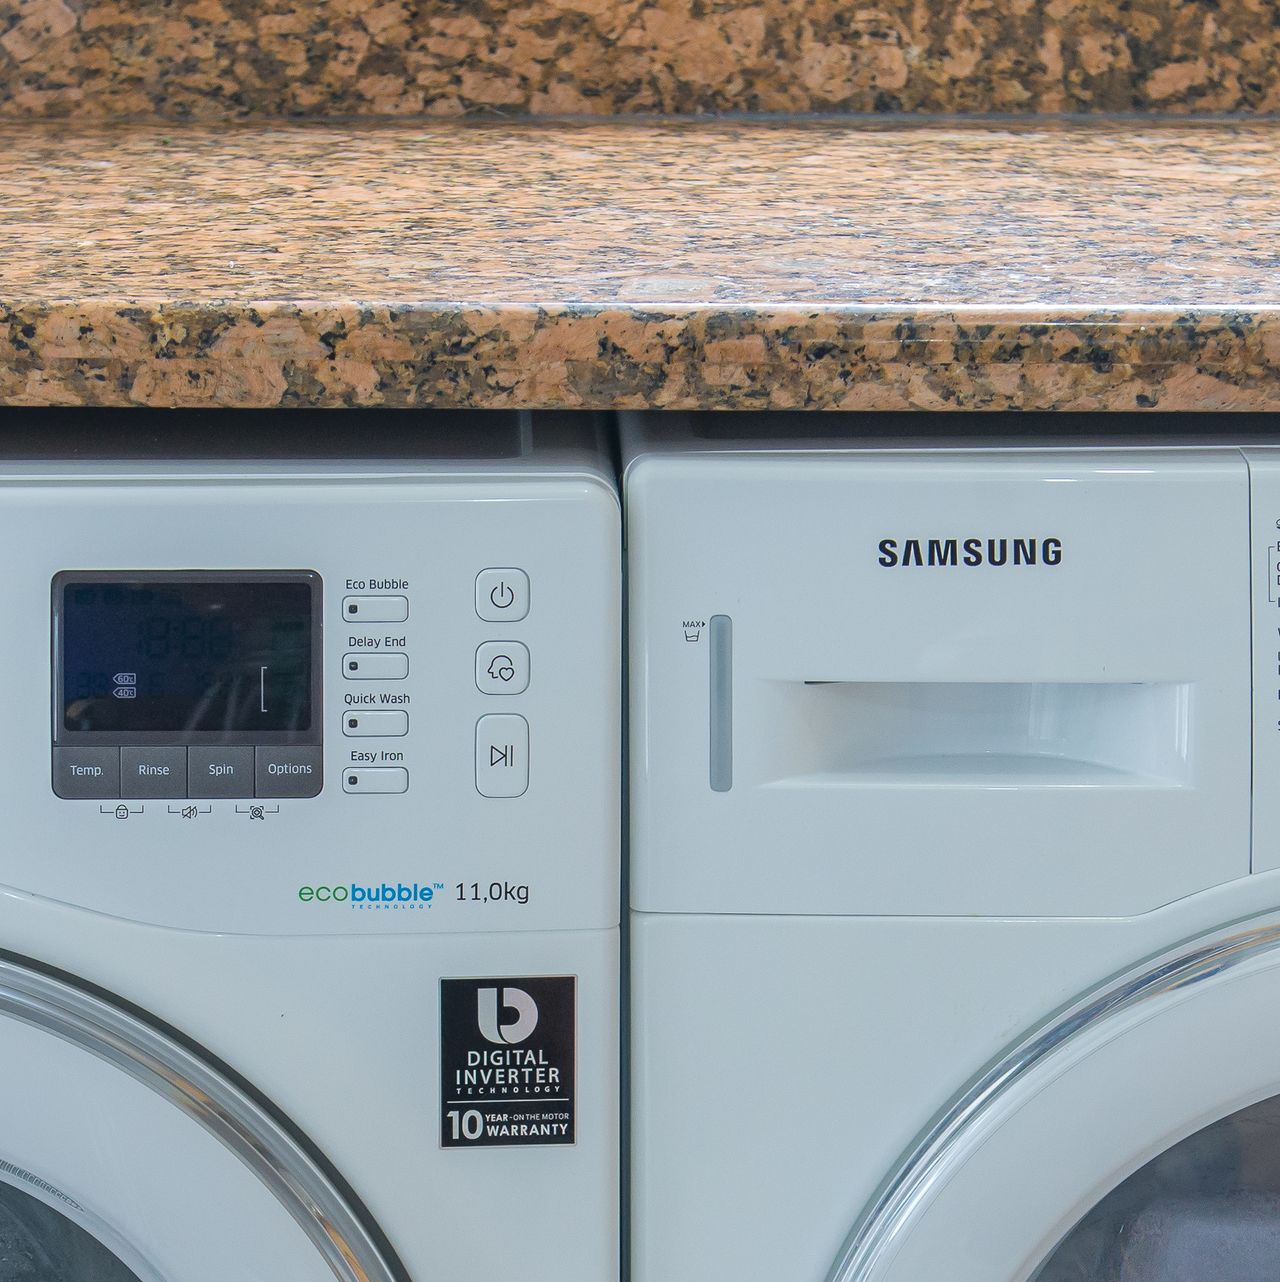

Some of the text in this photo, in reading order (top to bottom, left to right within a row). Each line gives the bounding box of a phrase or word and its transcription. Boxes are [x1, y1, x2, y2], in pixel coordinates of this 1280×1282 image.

[878, 537, 1063, 567] SAMSUNG
[345, 579, 409, 591] Eco Bubble
[348, 636, 406, 649] Delay End
[343, 693, 411, 706] Quick Wash
[350, 750, 404, 764] Easy Iron
[70, 765, 104, 777] Temp.
[138, 764, 170, 775] Rinse
[208, 764, 234, 777] Spin
[268, 763, 312, 776] Options
[455, 882, 529, 904] 11,0kg
[467, 1050, 549, 1066] DIGITAL
[456, 1068, 560, 1085] INVERTER
[456, 1085, 560, 1094] TECHNOLOGY
[485, 1114, 525, 1122] YEAR-ON
[526, 1113, 541, 1121] THE
[446, 1109, 484, 1140] 10
[486, 1123, 568, 1136] WARRANTY
